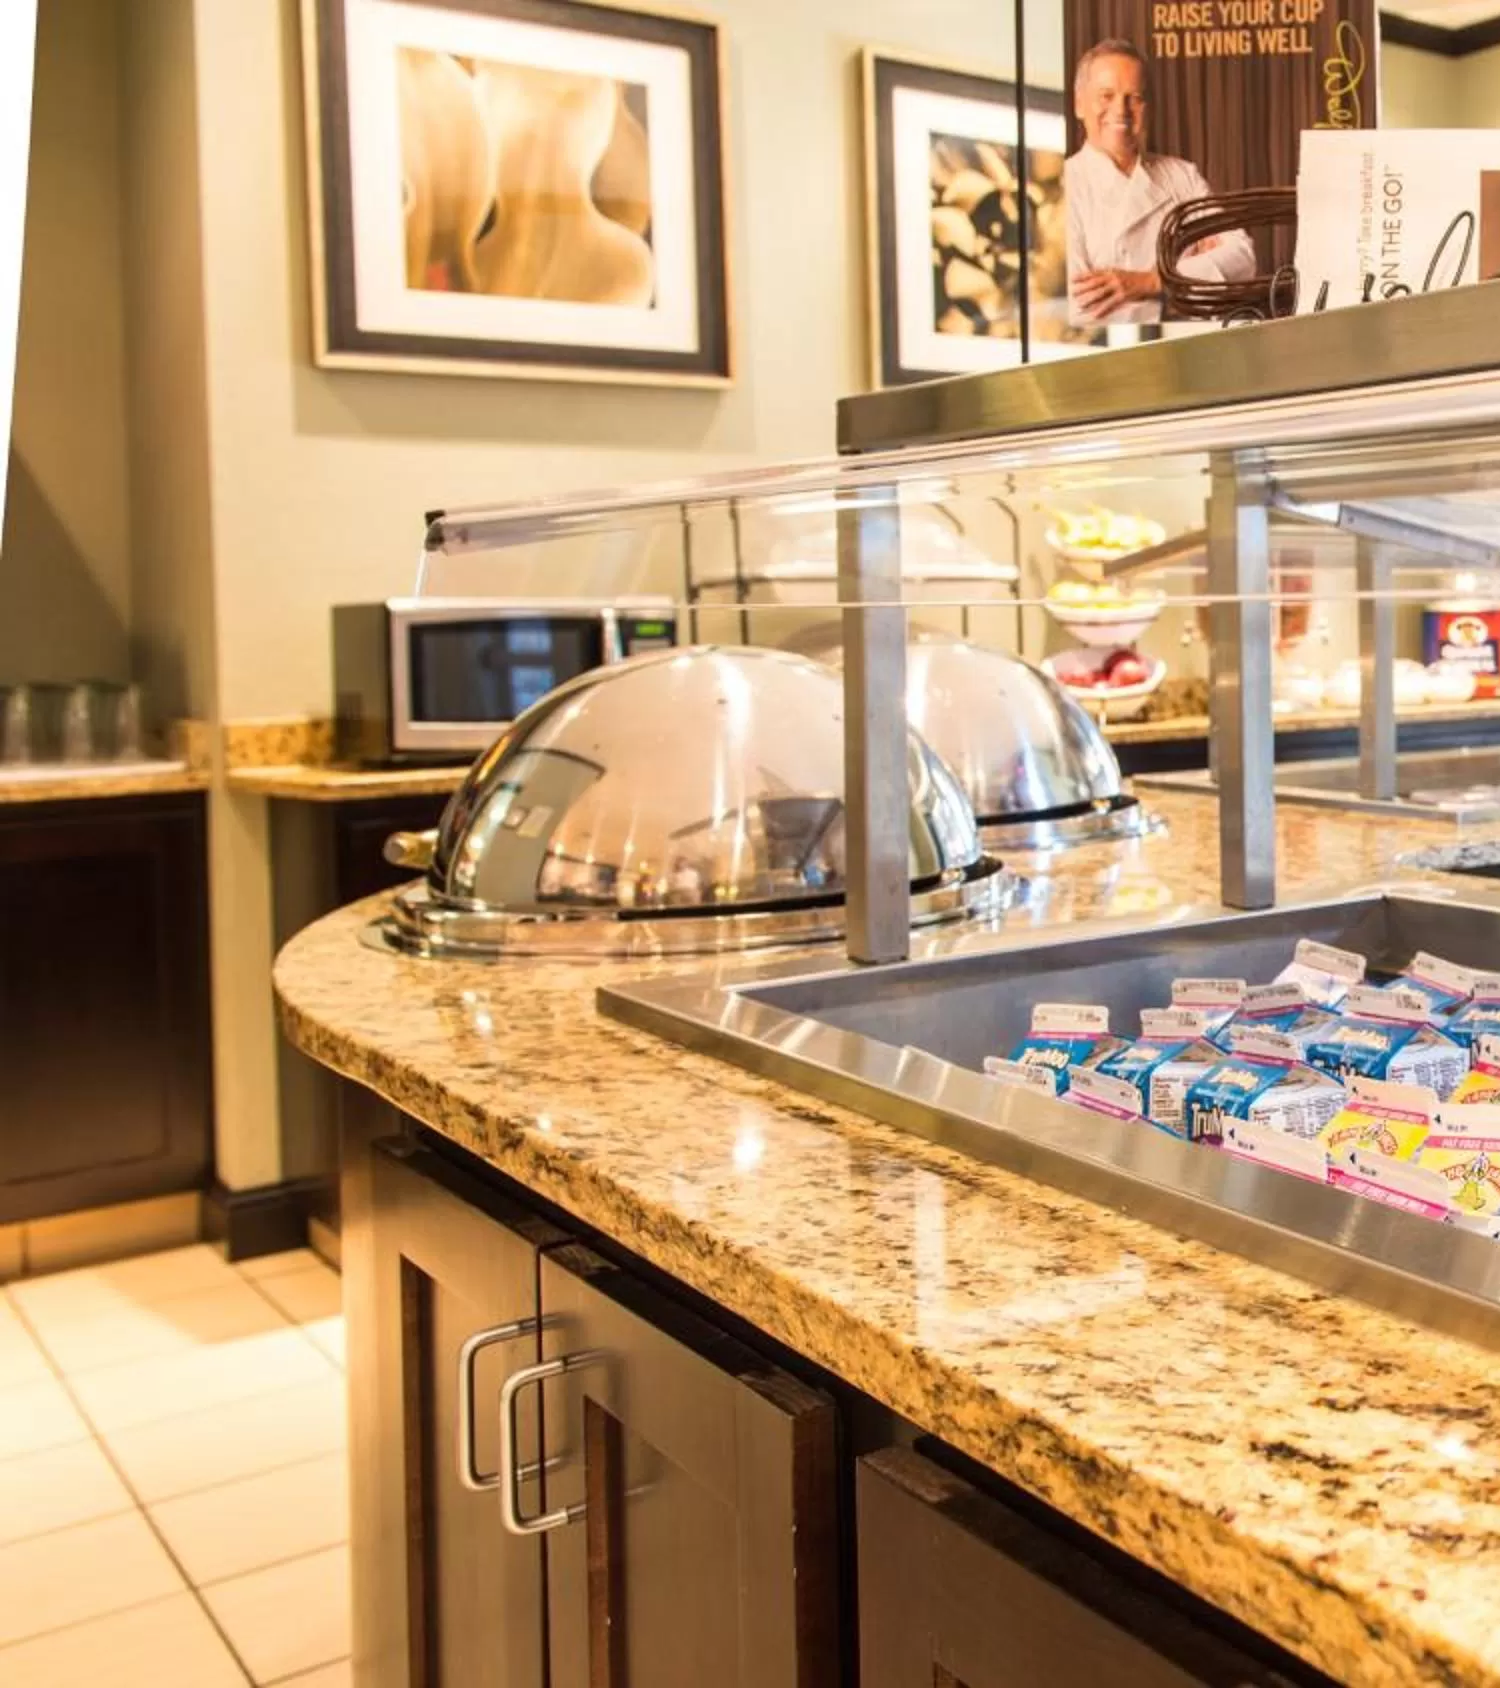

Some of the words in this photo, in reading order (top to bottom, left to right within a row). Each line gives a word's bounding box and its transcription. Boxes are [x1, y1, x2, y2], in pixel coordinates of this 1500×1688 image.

[1154, 2, 1214, 29] RAISE
[1218, 0, 1276, 25] YOUR
[1280, 0, 1325, 24] CUP
[1153, 32, 1179, 58] TO
[1184, 30, 1252, 57] LIVING
[1256, 28, 1314, 55] WELL
[1381, 219, 1401, 257] THE
